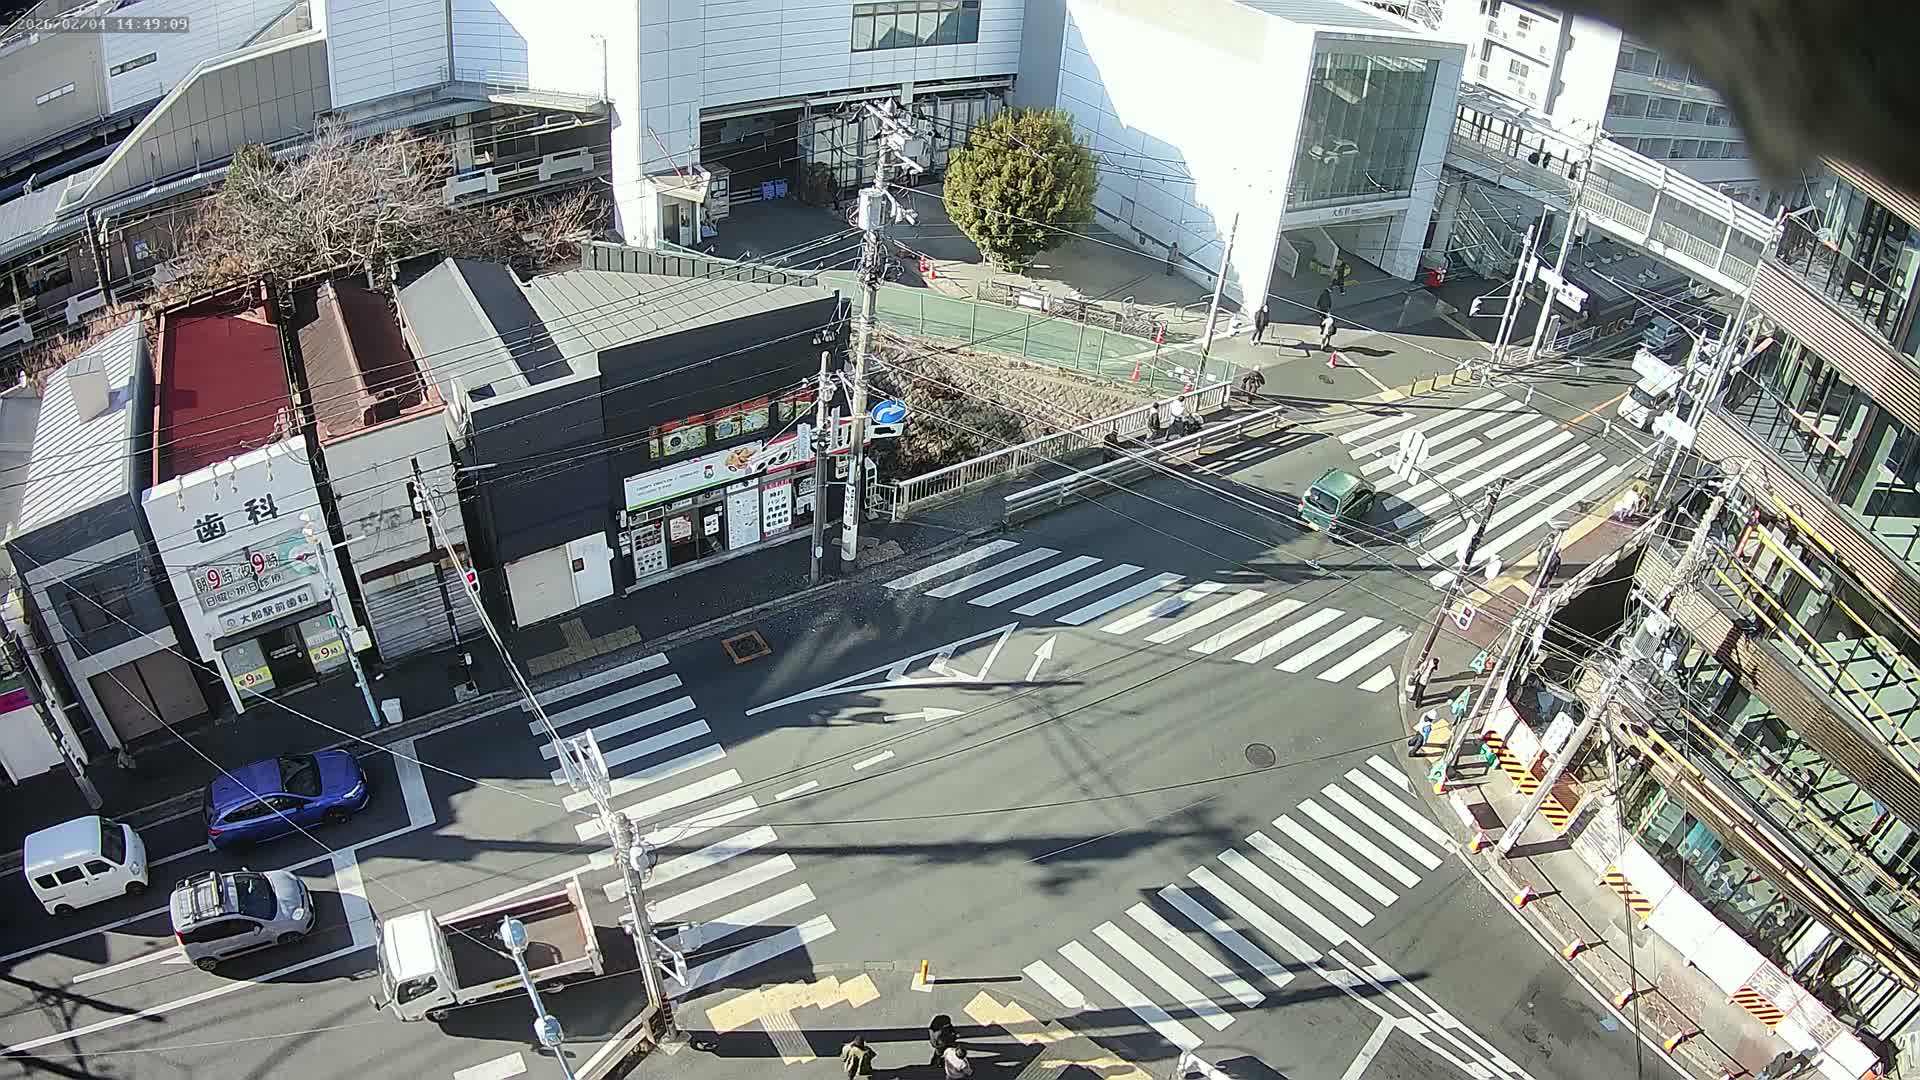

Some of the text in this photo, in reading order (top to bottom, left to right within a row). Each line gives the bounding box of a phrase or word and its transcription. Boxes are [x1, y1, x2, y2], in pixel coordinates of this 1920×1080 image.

[193, 493, 279, 543] 歯科
[240, 592, 309, 625] 大船駅前歯科
